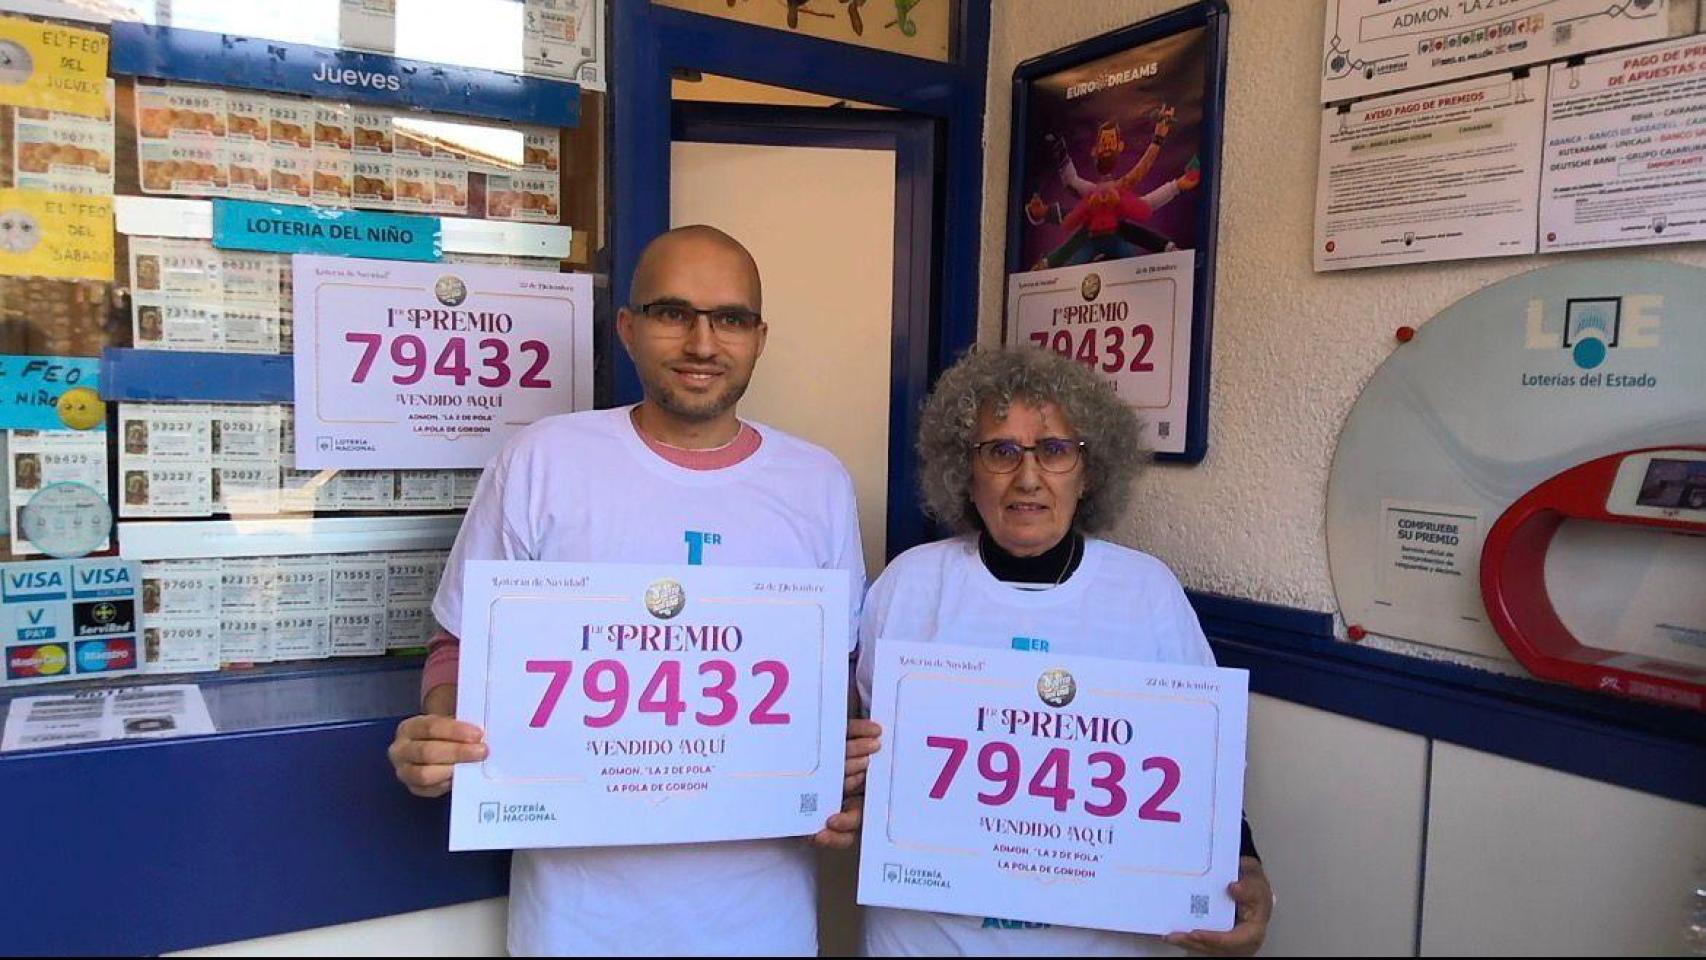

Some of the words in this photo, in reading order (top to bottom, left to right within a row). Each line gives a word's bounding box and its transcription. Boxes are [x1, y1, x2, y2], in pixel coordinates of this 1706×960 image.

[1623, 55, 1659, 69] PAGO
[1662, 50, 1680, 62] DE
[312, 61, 401, 91] Jueves
[1066, 81, 1097, 99] EURO
[1107, 62, 1158, 88] DREAMS
[1608, 75, 1625, 86] DE
[1628, 63, 1695, 82] APUESTAS
[1364, 108, 1393, 121] AVISO
[1394, 103, 1420, 115] PAGO
[1422, 100, 1435, 110] DE
[1438, 92, 1485, 108] PREMIOS
[247, 217, 323, 237] LOTERIA
[329, 224, 361, 241] DEL
[368, 225, 414, 245] NIÑO
[408, 309, 513, 334] PREMIO
[1064, 301, 1129, 325] PREMIO
[345, 332, 552, 389] 79432
[21, 360, 81, 384] FEO
[1521, 372, 1577, 388] Loterías
[1580, 372, 1602, 387] del
[1605, 373, 1657, 388] Estado
[1398, 519, 1459, 534] COMPRUEBE
[1398, 529, 1413, 540] SU
[1416, 532, 1459, 546] PREMIO
[11, 571, 63, 588] VISA
[80, 567, 130, 585] VISA
[27, 608, 44, 624] V
[80, 621, 131, 636] ServiRed
[608, 624, 743, 652] PREMIO
[525, 659, 791, 728] 79432
[1001, 707, 1134, 745] PREMIO
[586, 739, 673, 756] VENDIDO
[672, 766, 684, 775] DE
[926, 736, 1182, 823] 79432
[607, 784, 618, 793] LA
[621, 783, 648, 793] POLA
[651, 783, 663, 792] DE
[665, 781, 708, 792] GORDON
[503, 813, 557, 823] NACIONAL
[979, 816, 1061, 840] VENDIDO
[1059, 851, 1072, 860] DE
[998, 860, 1011, 870] LA
[1012, 861, 1037, 873] POLA
[1039, 864, 1052, 874] DE
[1054, 866, 1096, 879] GORDON
[903, 877, 951, 889] NACIONAL
